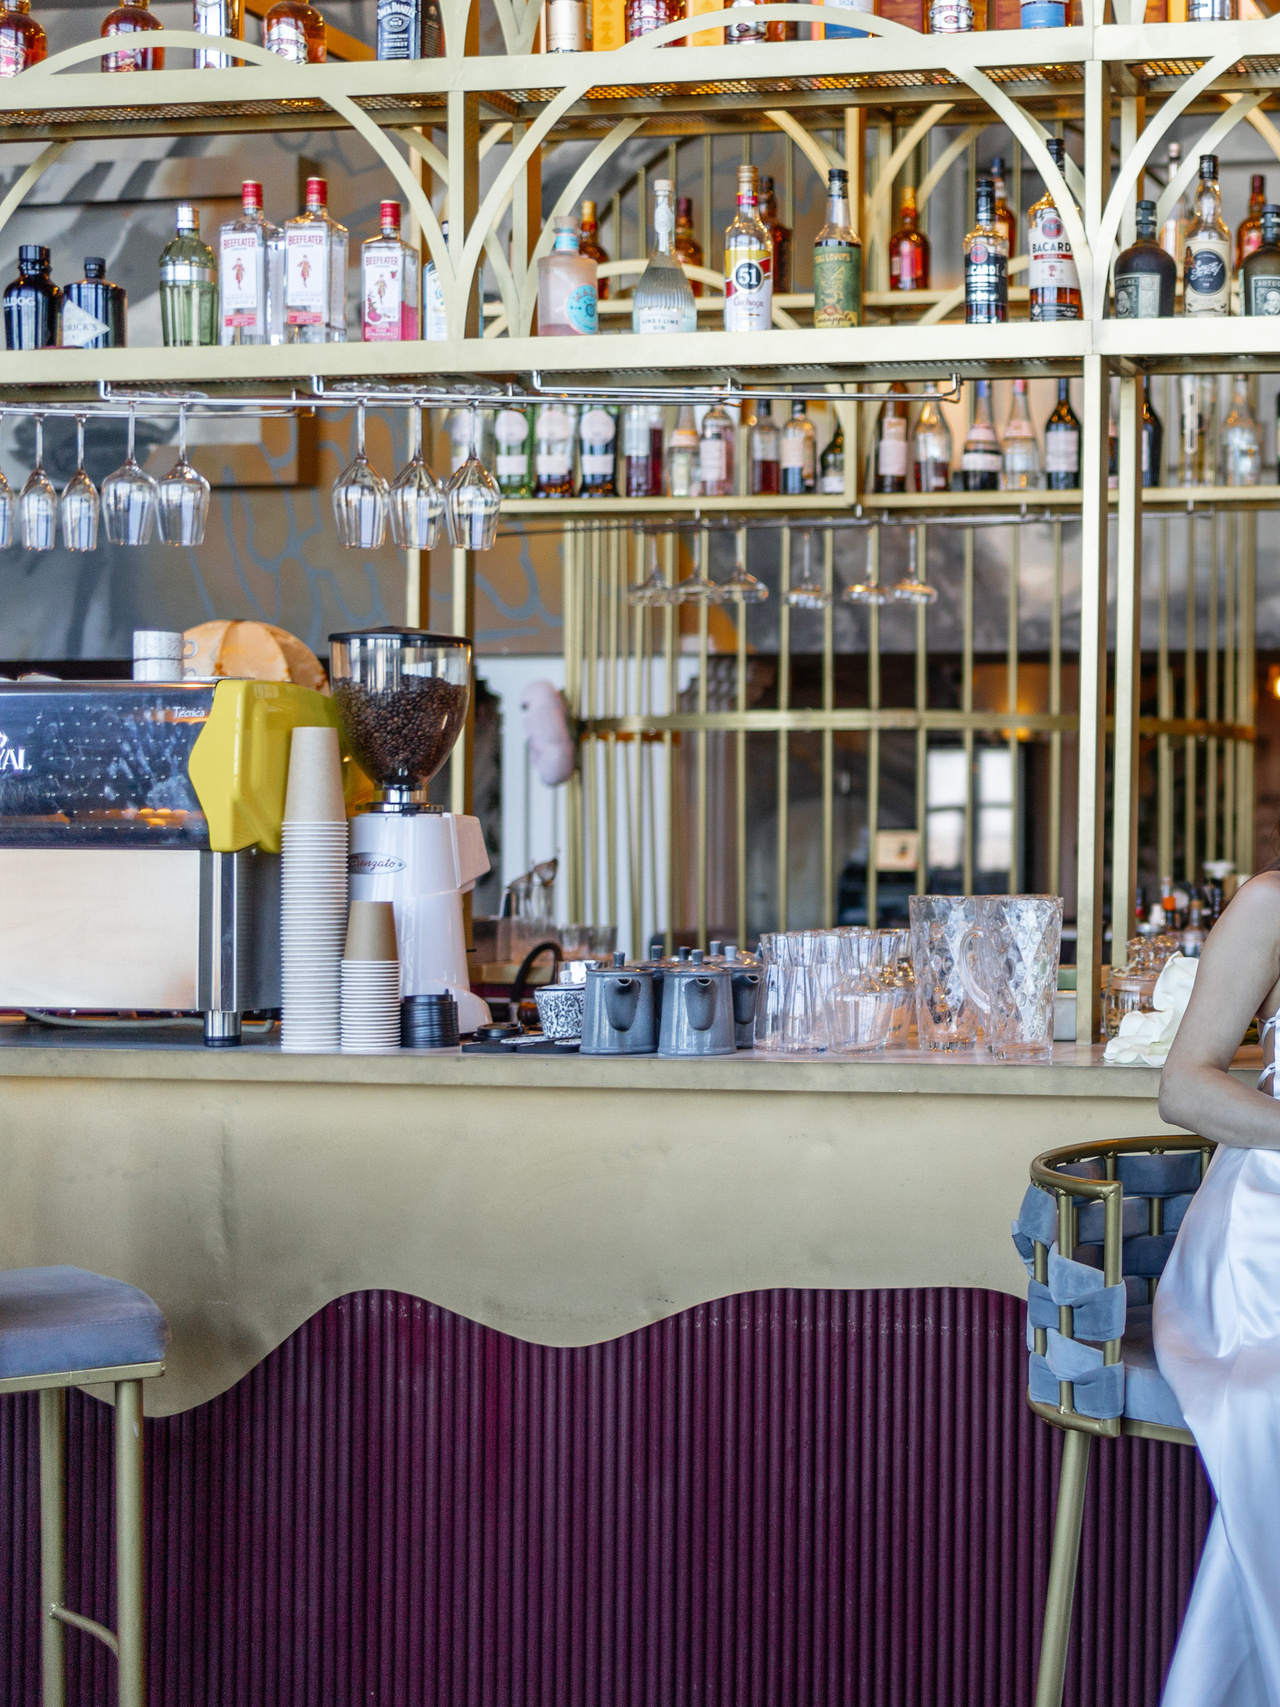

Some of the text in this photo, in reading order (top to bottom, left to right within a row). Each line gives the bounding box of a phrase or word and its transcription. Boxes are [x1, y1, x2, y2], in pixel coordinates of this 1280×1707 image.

[223, 238, 256, 250] BEEFEATER
[288, 235, 323, 246] BEEFEATER
[1032, 242, 1072, 253] BACARD
[366, 256, 398, 267] BEEFEATER
[738, 267, 758, 285] 51
[3, 296, 36, 307] LLDOG
[64, 323, 98, 332] DRICK'S
